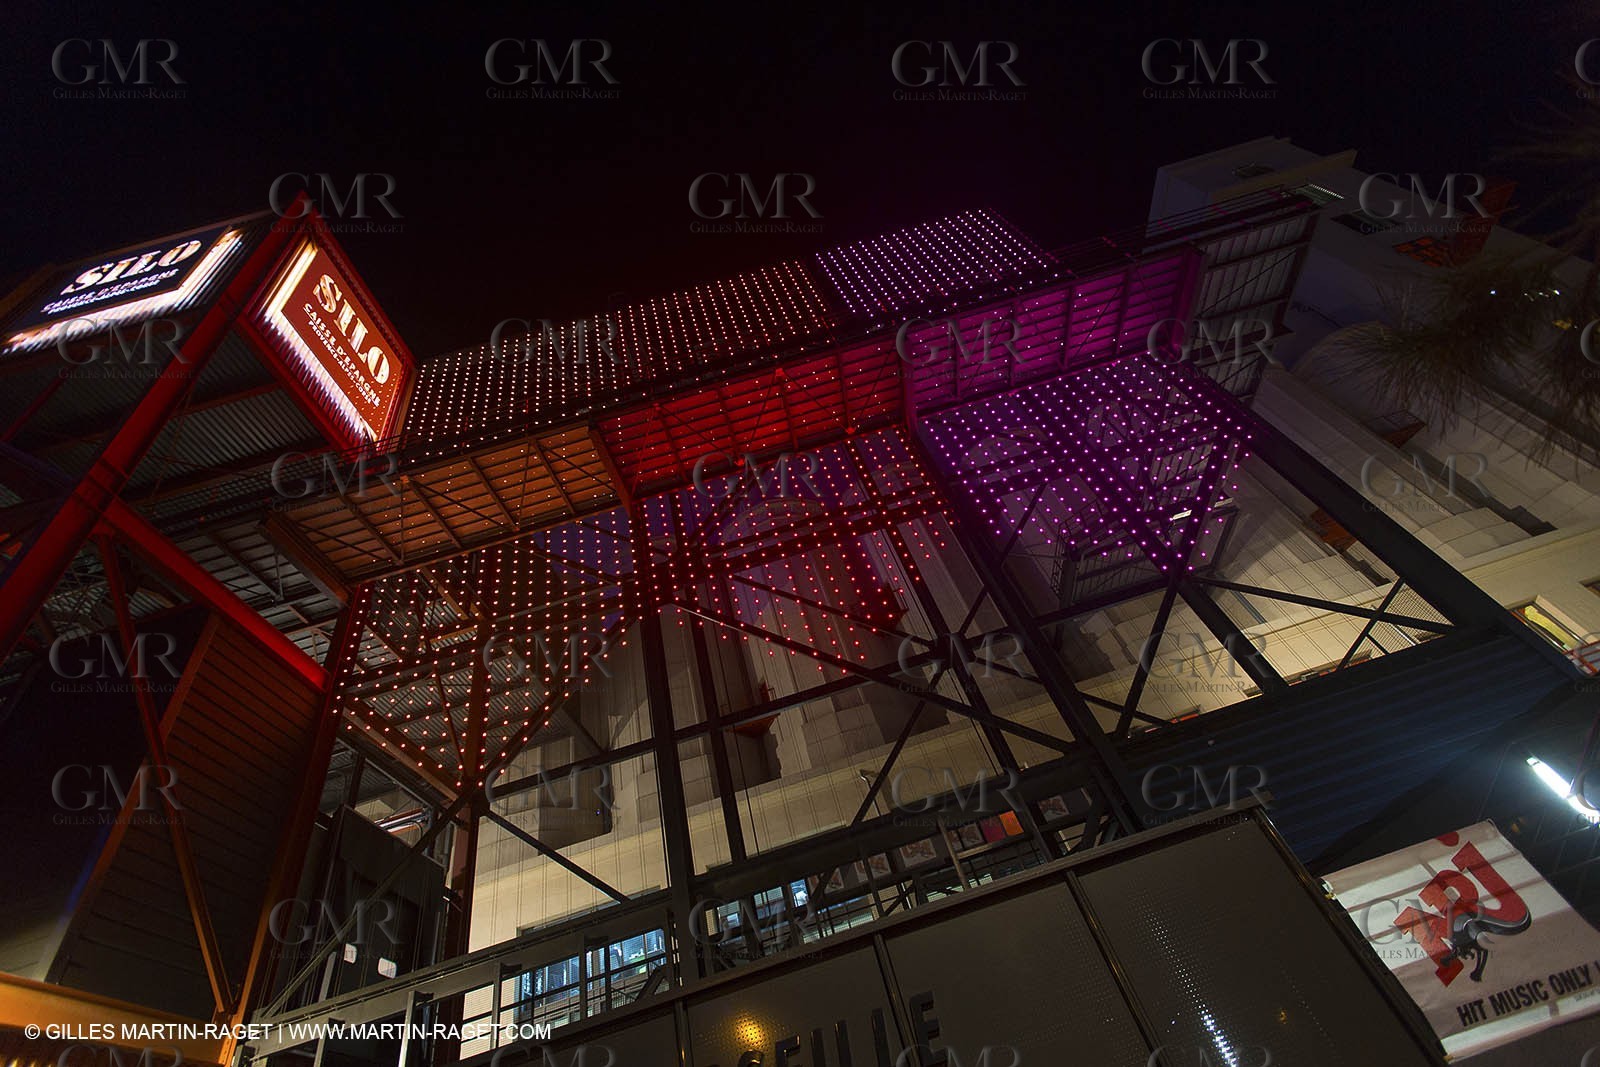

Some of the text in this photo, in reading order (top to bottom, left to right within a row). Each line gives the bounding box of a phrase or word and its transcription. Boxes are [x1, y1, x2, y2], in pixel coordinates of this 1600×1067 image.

[60, 240, 202, 295] SILO
[303, 303, 381, 407] CAISSE D'EPARGNE
[313, 274, 390, 384] SILO
[1456, 999, 1487, 1027] HIT
[1488, 979, 1549, 1016] MUSIC
[1548, 964, 1592, 996] ONLY
